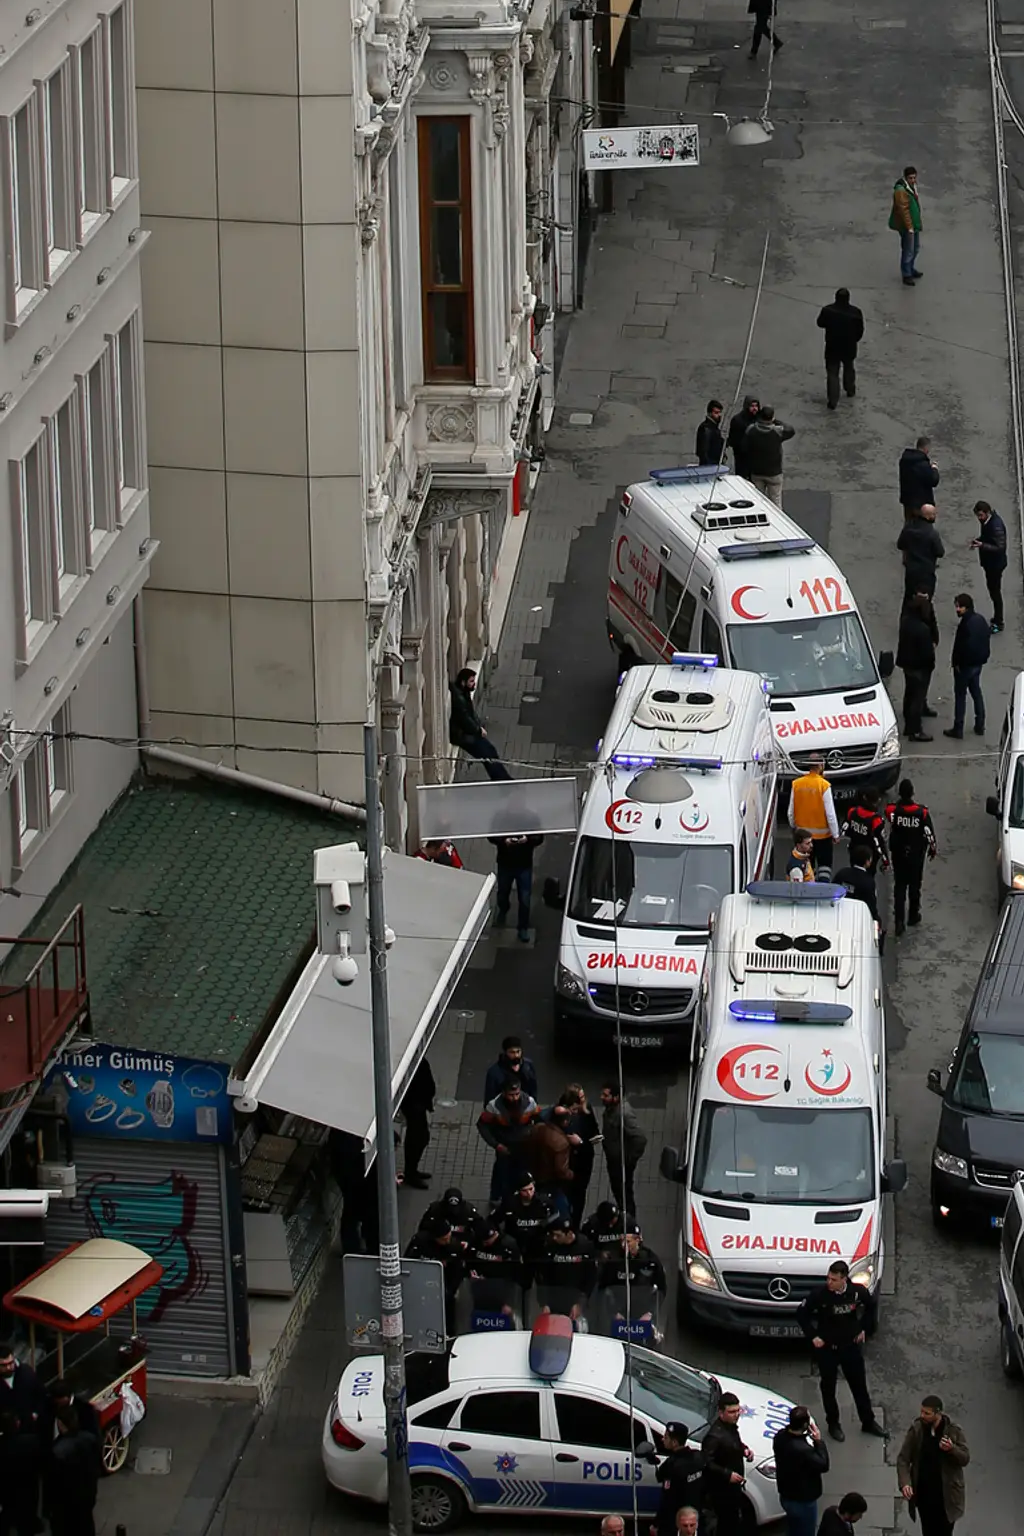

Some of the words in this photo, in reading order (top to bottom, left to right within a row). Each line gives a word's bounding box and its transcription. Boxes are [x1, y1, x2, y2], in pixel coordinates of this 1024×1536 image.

[634, 578, 648, 608] 112
[800, 577, 850, 614] 112
[616, 809, 643, 824] 112
[897, 816, 920, 828] POLİS
[110, 1051, 175, 1077] Gümüş
[735, 1063, 779, 1080] 112
[476, 1317, 506, 1328] POLİS
[618, 1324, 644, 1334] POLİS
[582, 1457, 643, 1482] POLİS
